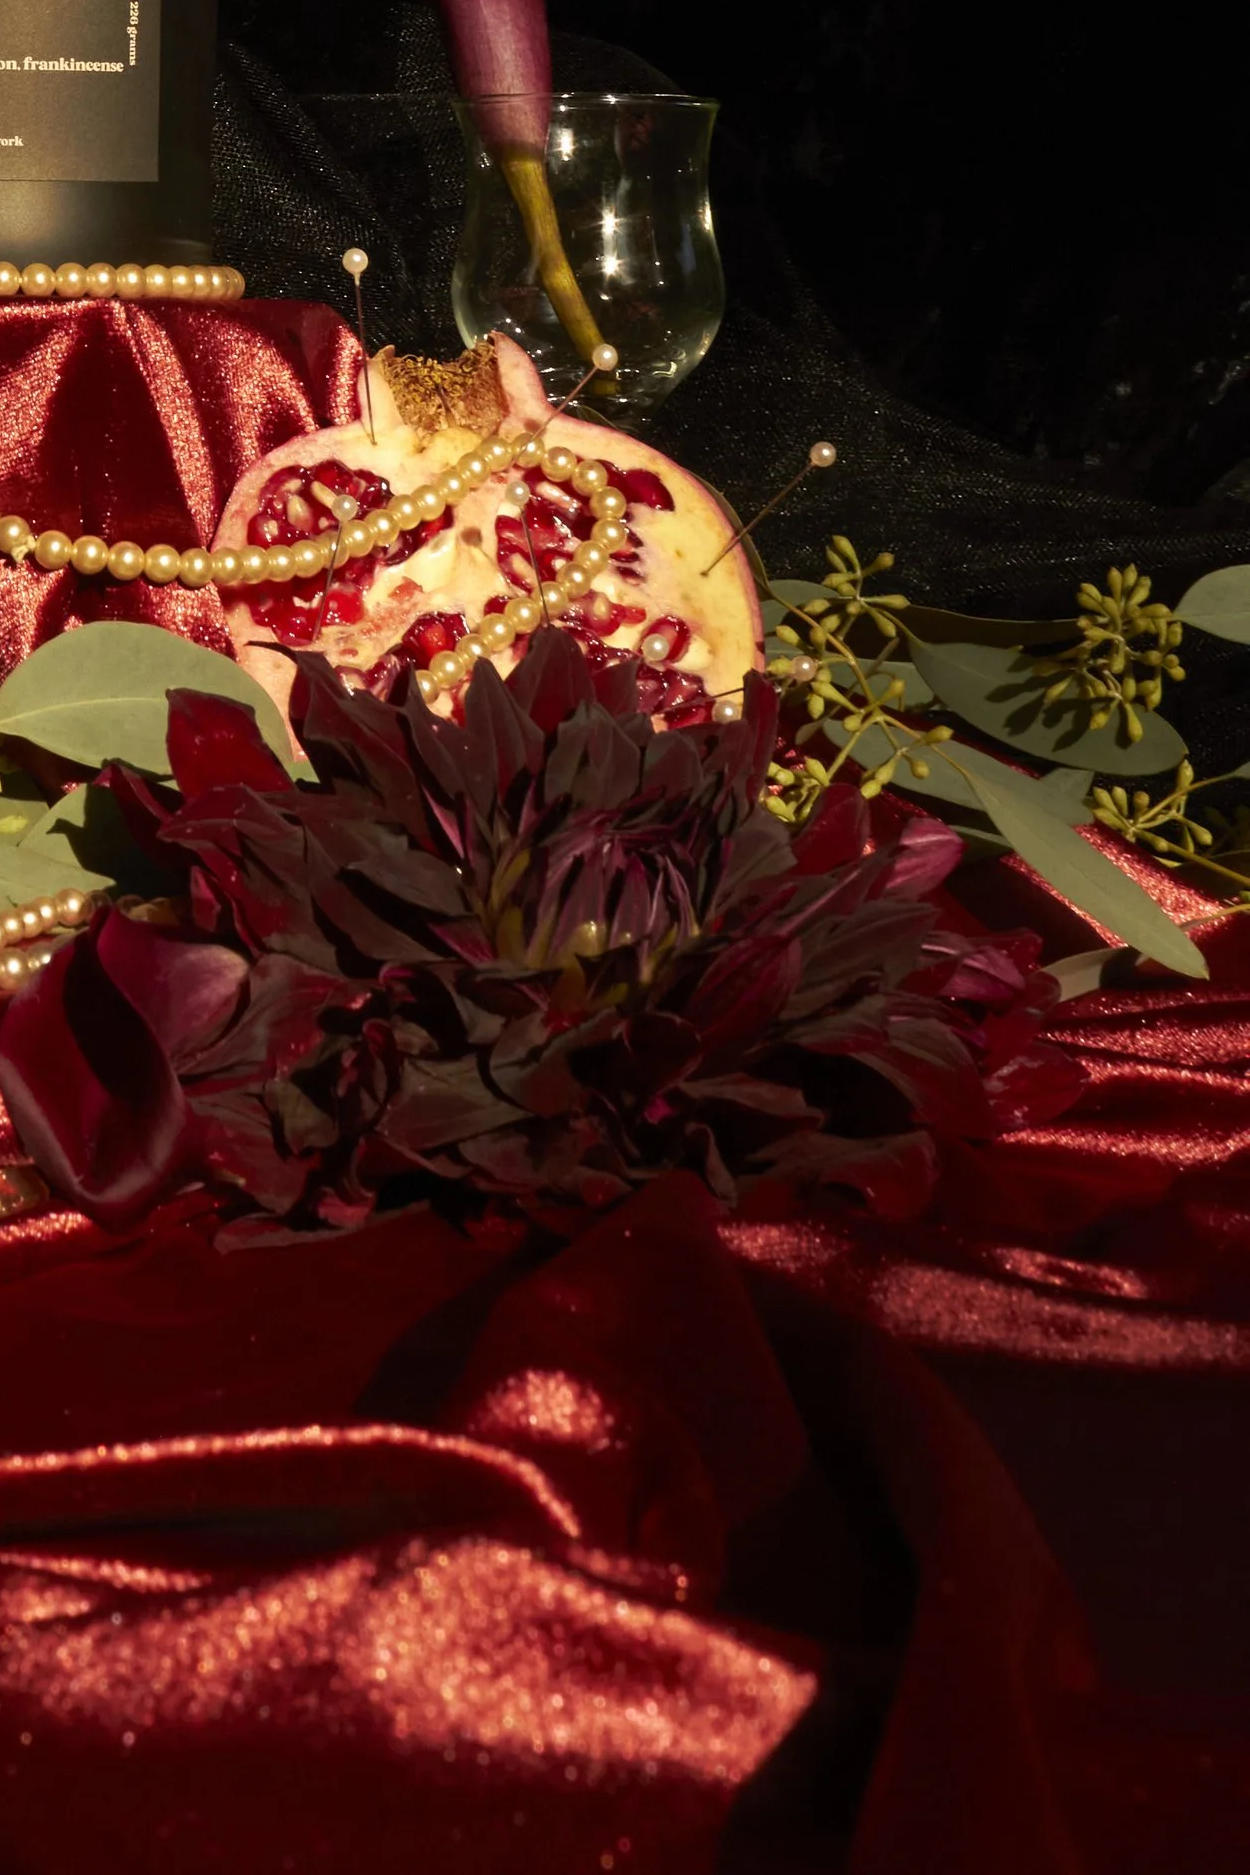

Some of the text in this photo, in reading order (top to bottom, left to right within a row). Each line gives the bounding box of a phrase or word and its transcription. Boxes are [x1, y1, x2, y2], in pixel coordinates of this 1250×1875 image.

[130, 1, 139, 25] 226
[126, 26, 138, 66] grams
[23, 56, 124, 72] frankincense
